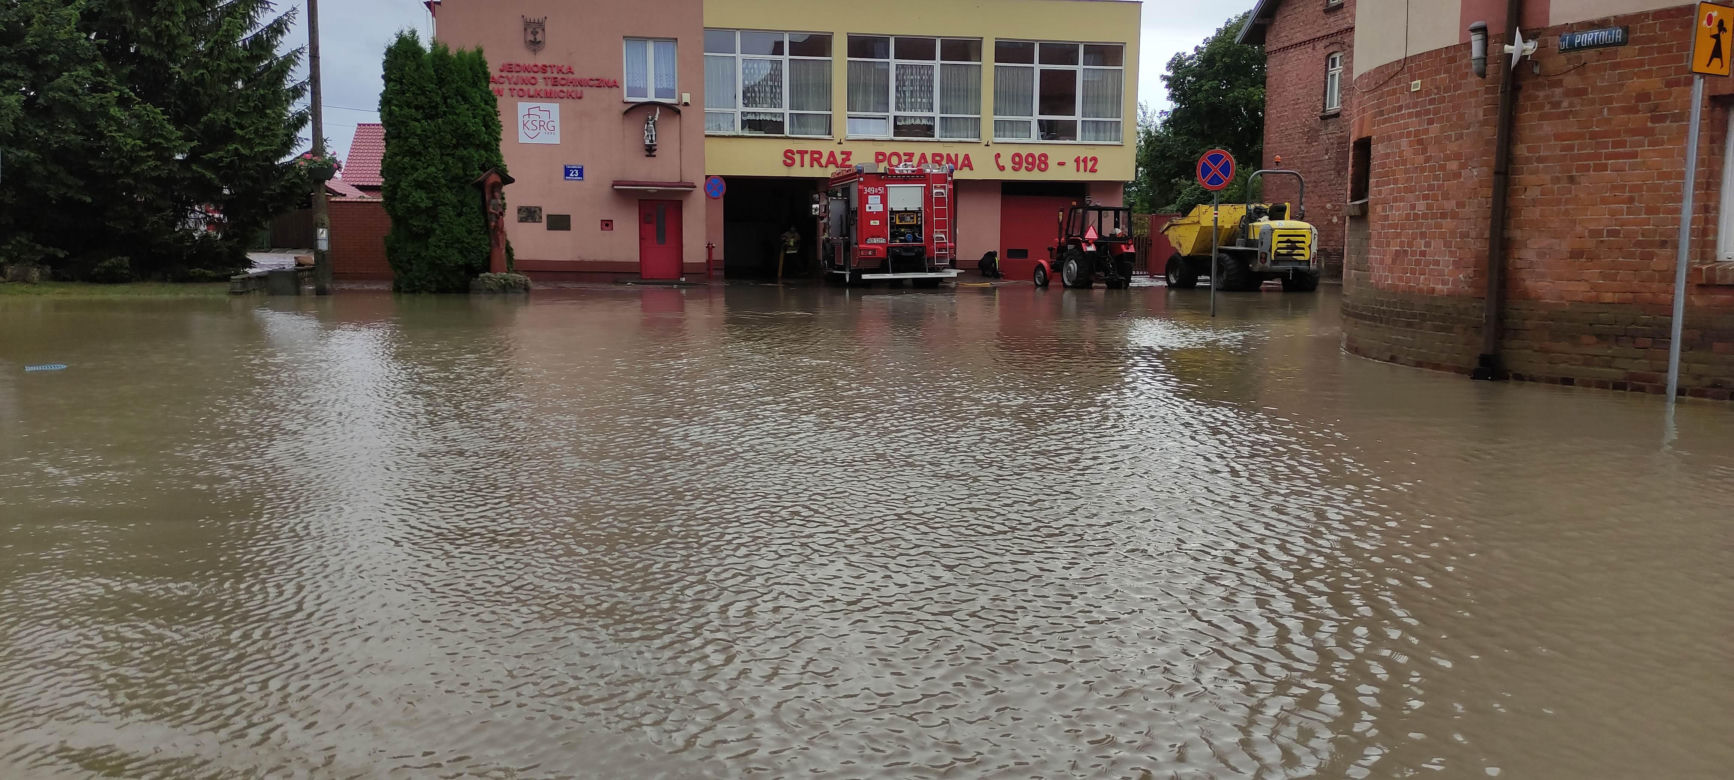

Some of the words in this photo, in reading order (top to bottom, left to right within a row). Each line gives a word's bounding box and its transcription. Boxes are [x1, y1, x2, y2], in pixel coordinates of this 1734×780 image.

[1574, 28, 1622, 47] PORTOWA
[499, 63, 575, 74] JEDNOSTKA
[543, 76, 619, 88] TECHNICZNA
[509, 88, 584, 100] TOLKMICKU
[523, 120, 556, 132] KSRG
[1011, 152, 1049, 172] 998
[1074, 156, 1098, 173] 112
[569, 169, 579, 177] 23
